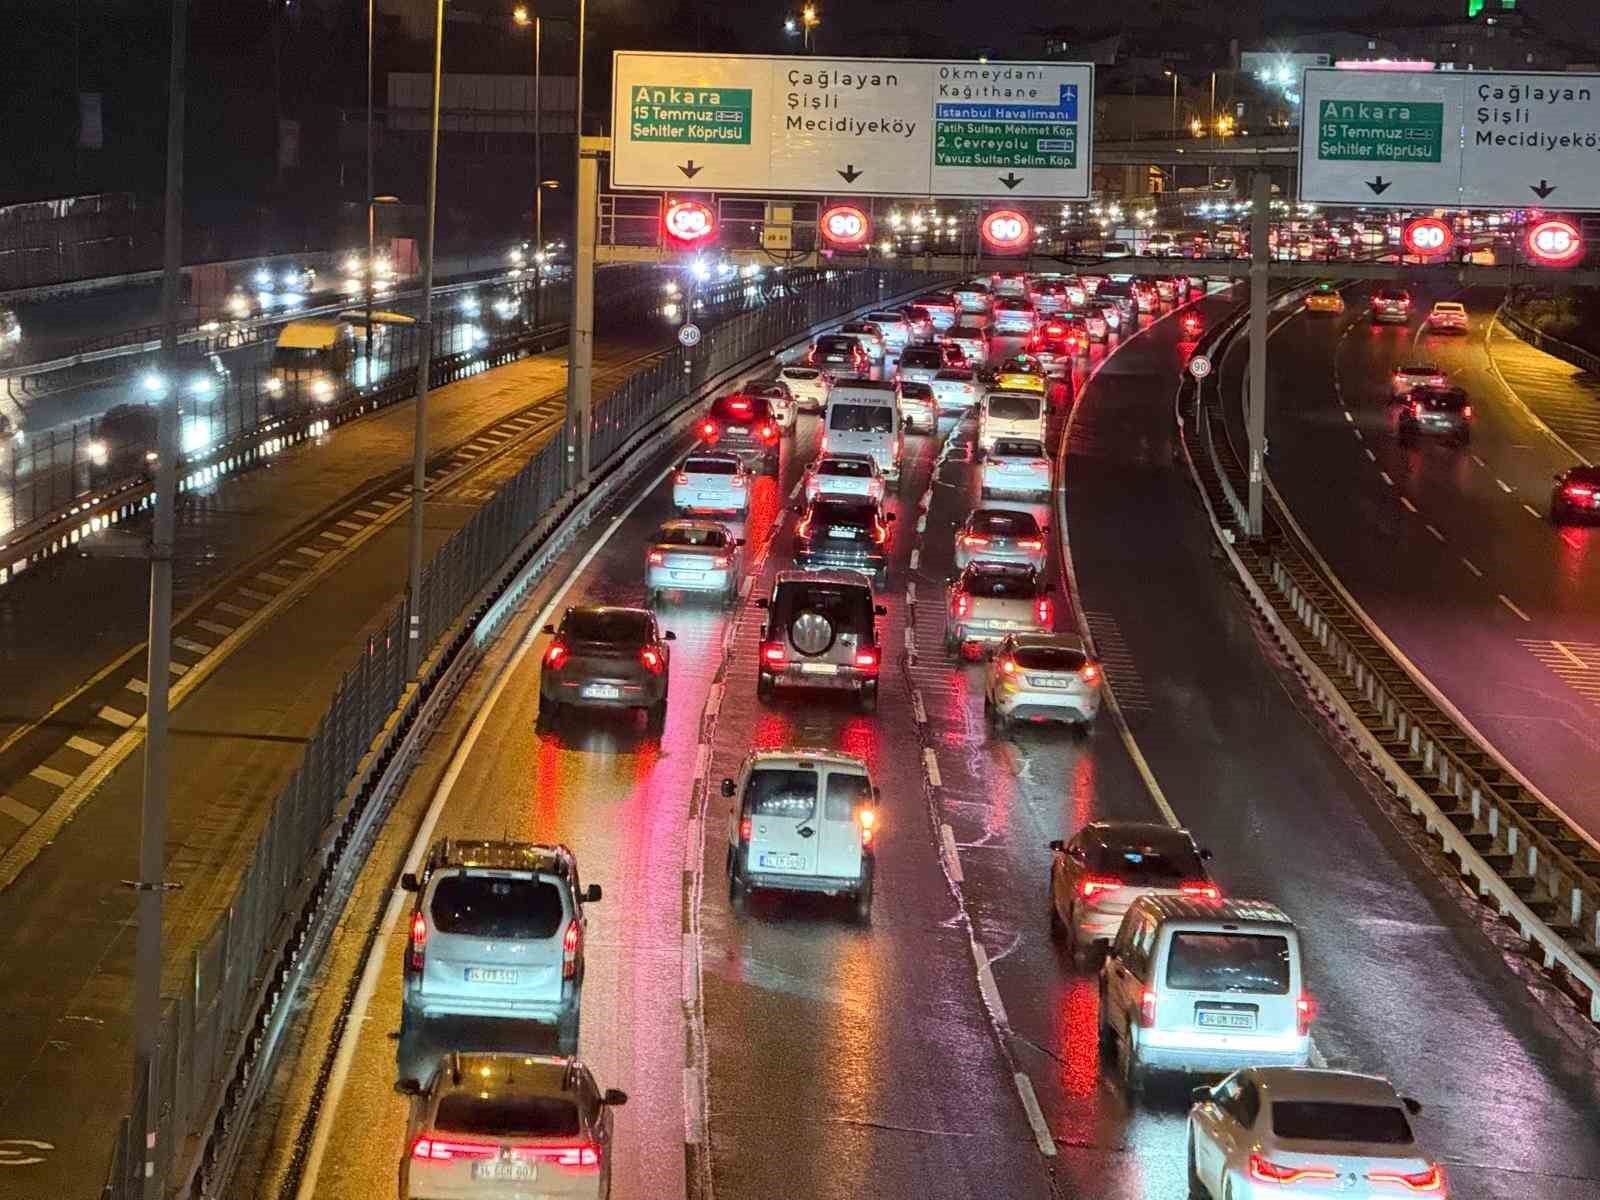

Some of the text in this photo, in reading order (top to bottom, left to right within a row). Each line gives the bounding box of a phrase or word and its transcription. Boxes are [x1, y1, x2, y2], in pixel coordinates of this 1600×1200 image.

[788, 70, 898, 90] Çağlayan
[939, 67, 1042, 82] Okmeydanı
[636, 87, 721, 105] Ankara
[939, 84, 1038, 99] Kağıthane
[1478, 84, 1591, 104] Çağlayan
[787, 93, 839, 110] Şişli
[633, 106, 714, 121] 15 Temmuz
[1323, 102, 1411, 120] Ankara
[1477, 107, 1530, 125] Şişli
[632, 123, 685, 137] Şehitler
[786, 115, 916, 138] Mecidiyeköy
[967, 123, 1001, 134] Sultan
[1005, 125, 1050, 136] Mehmet
[1321, 124, 1403, 139] 15 Temmuz
[937, 136, 1029, 151] 2. Çevreyolu
[1320, 141, 1374, 156] Şehitler
[1475, 130, 1600, 151] Mecidiyekö
[937, 152, 972, 164] Yavuz
[974, 153, 1011, 165] Sultan
[1014, 154, 1047, 166] Selim
[829, 214, 861, 236] 90
[990, 218, 1022, 241] 90
[1412, 226, 1445, 247] 90
[683, 329, 696, 341] 90
[1194, 361, 1206, 373] 90
